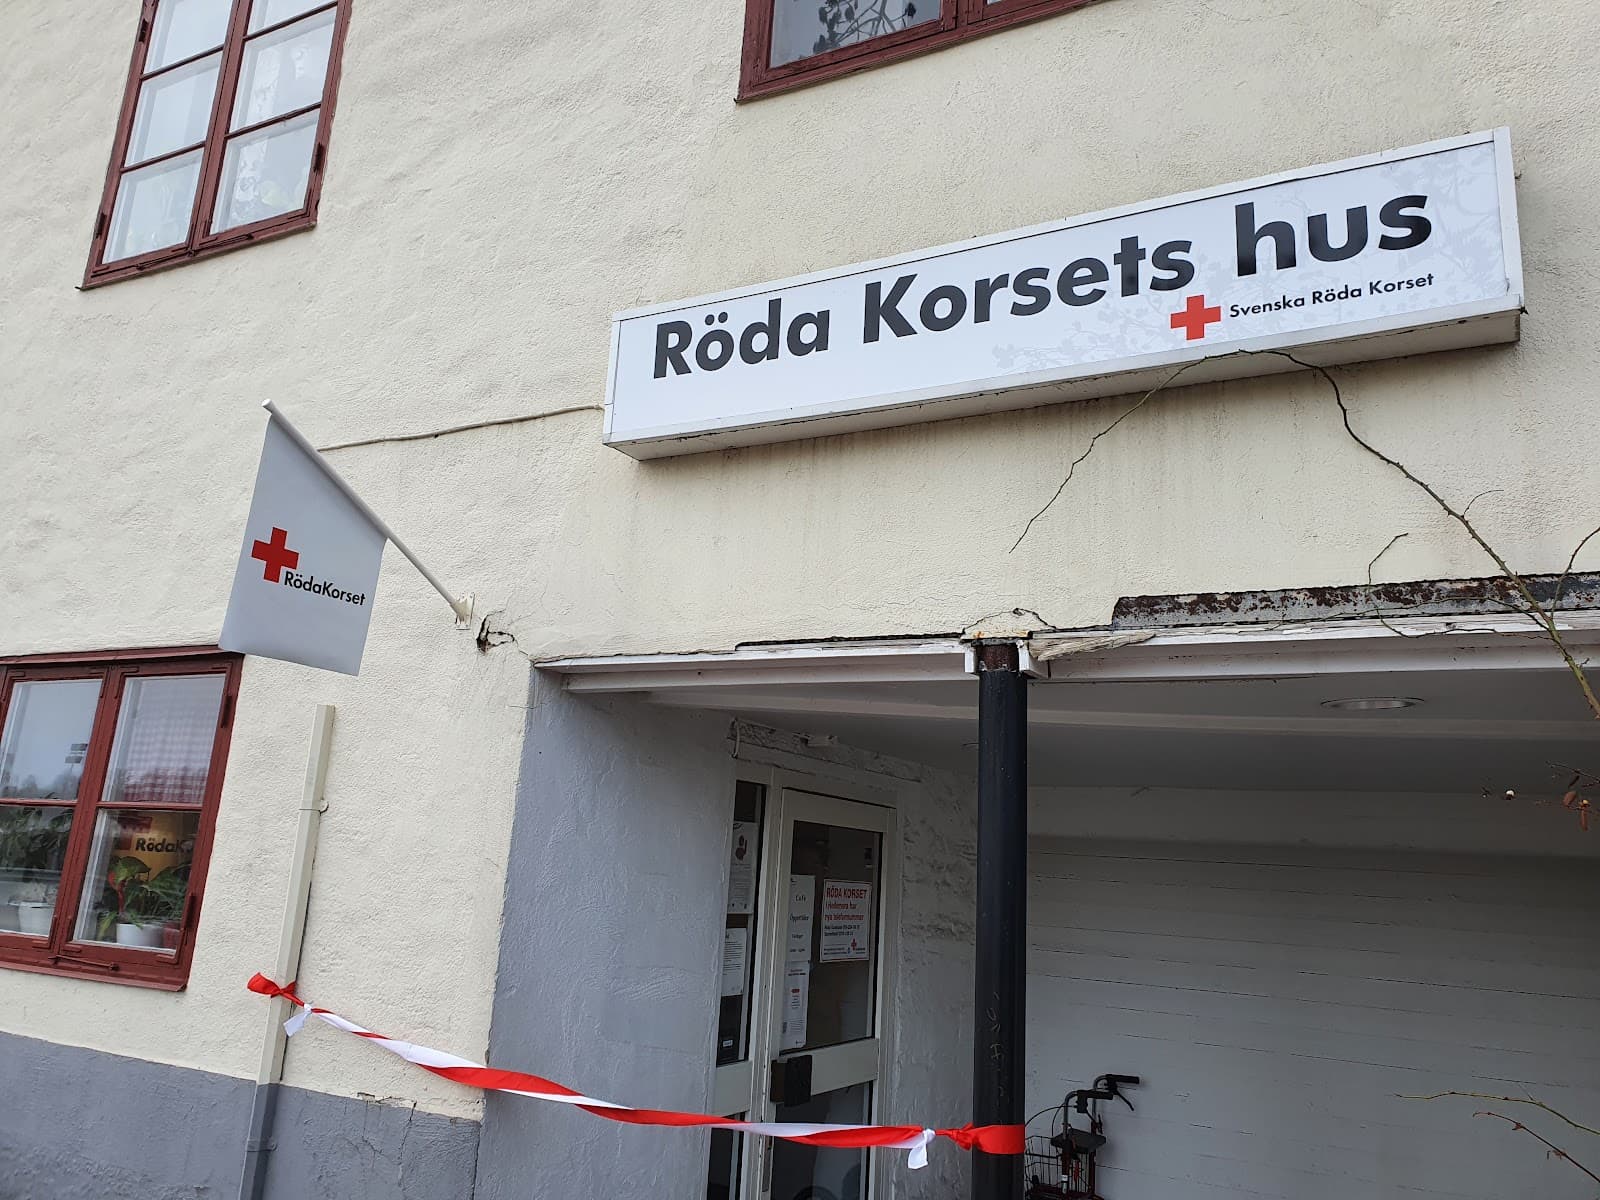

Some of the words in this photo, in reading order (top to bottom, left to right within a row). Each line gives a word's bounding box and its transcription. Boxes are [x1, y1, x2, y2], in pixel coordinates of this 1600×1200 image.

[653, 297, 831, 380] Röda
[863, 235, 1195, 344] Korsets
[1234, 194, 1432, 277] hus
[1229, 294, 1305, 318] Svenska
[1312, 284, 1362, 305] Röda
[1369, 273, 1434, 296] Korset
[283, 570, 366, 607] RödaKorset
[135, 837, 193, 853] RödaK
[826, 885, 842, 898] RÖDA
[843, 888, 867, 899] KORSET
